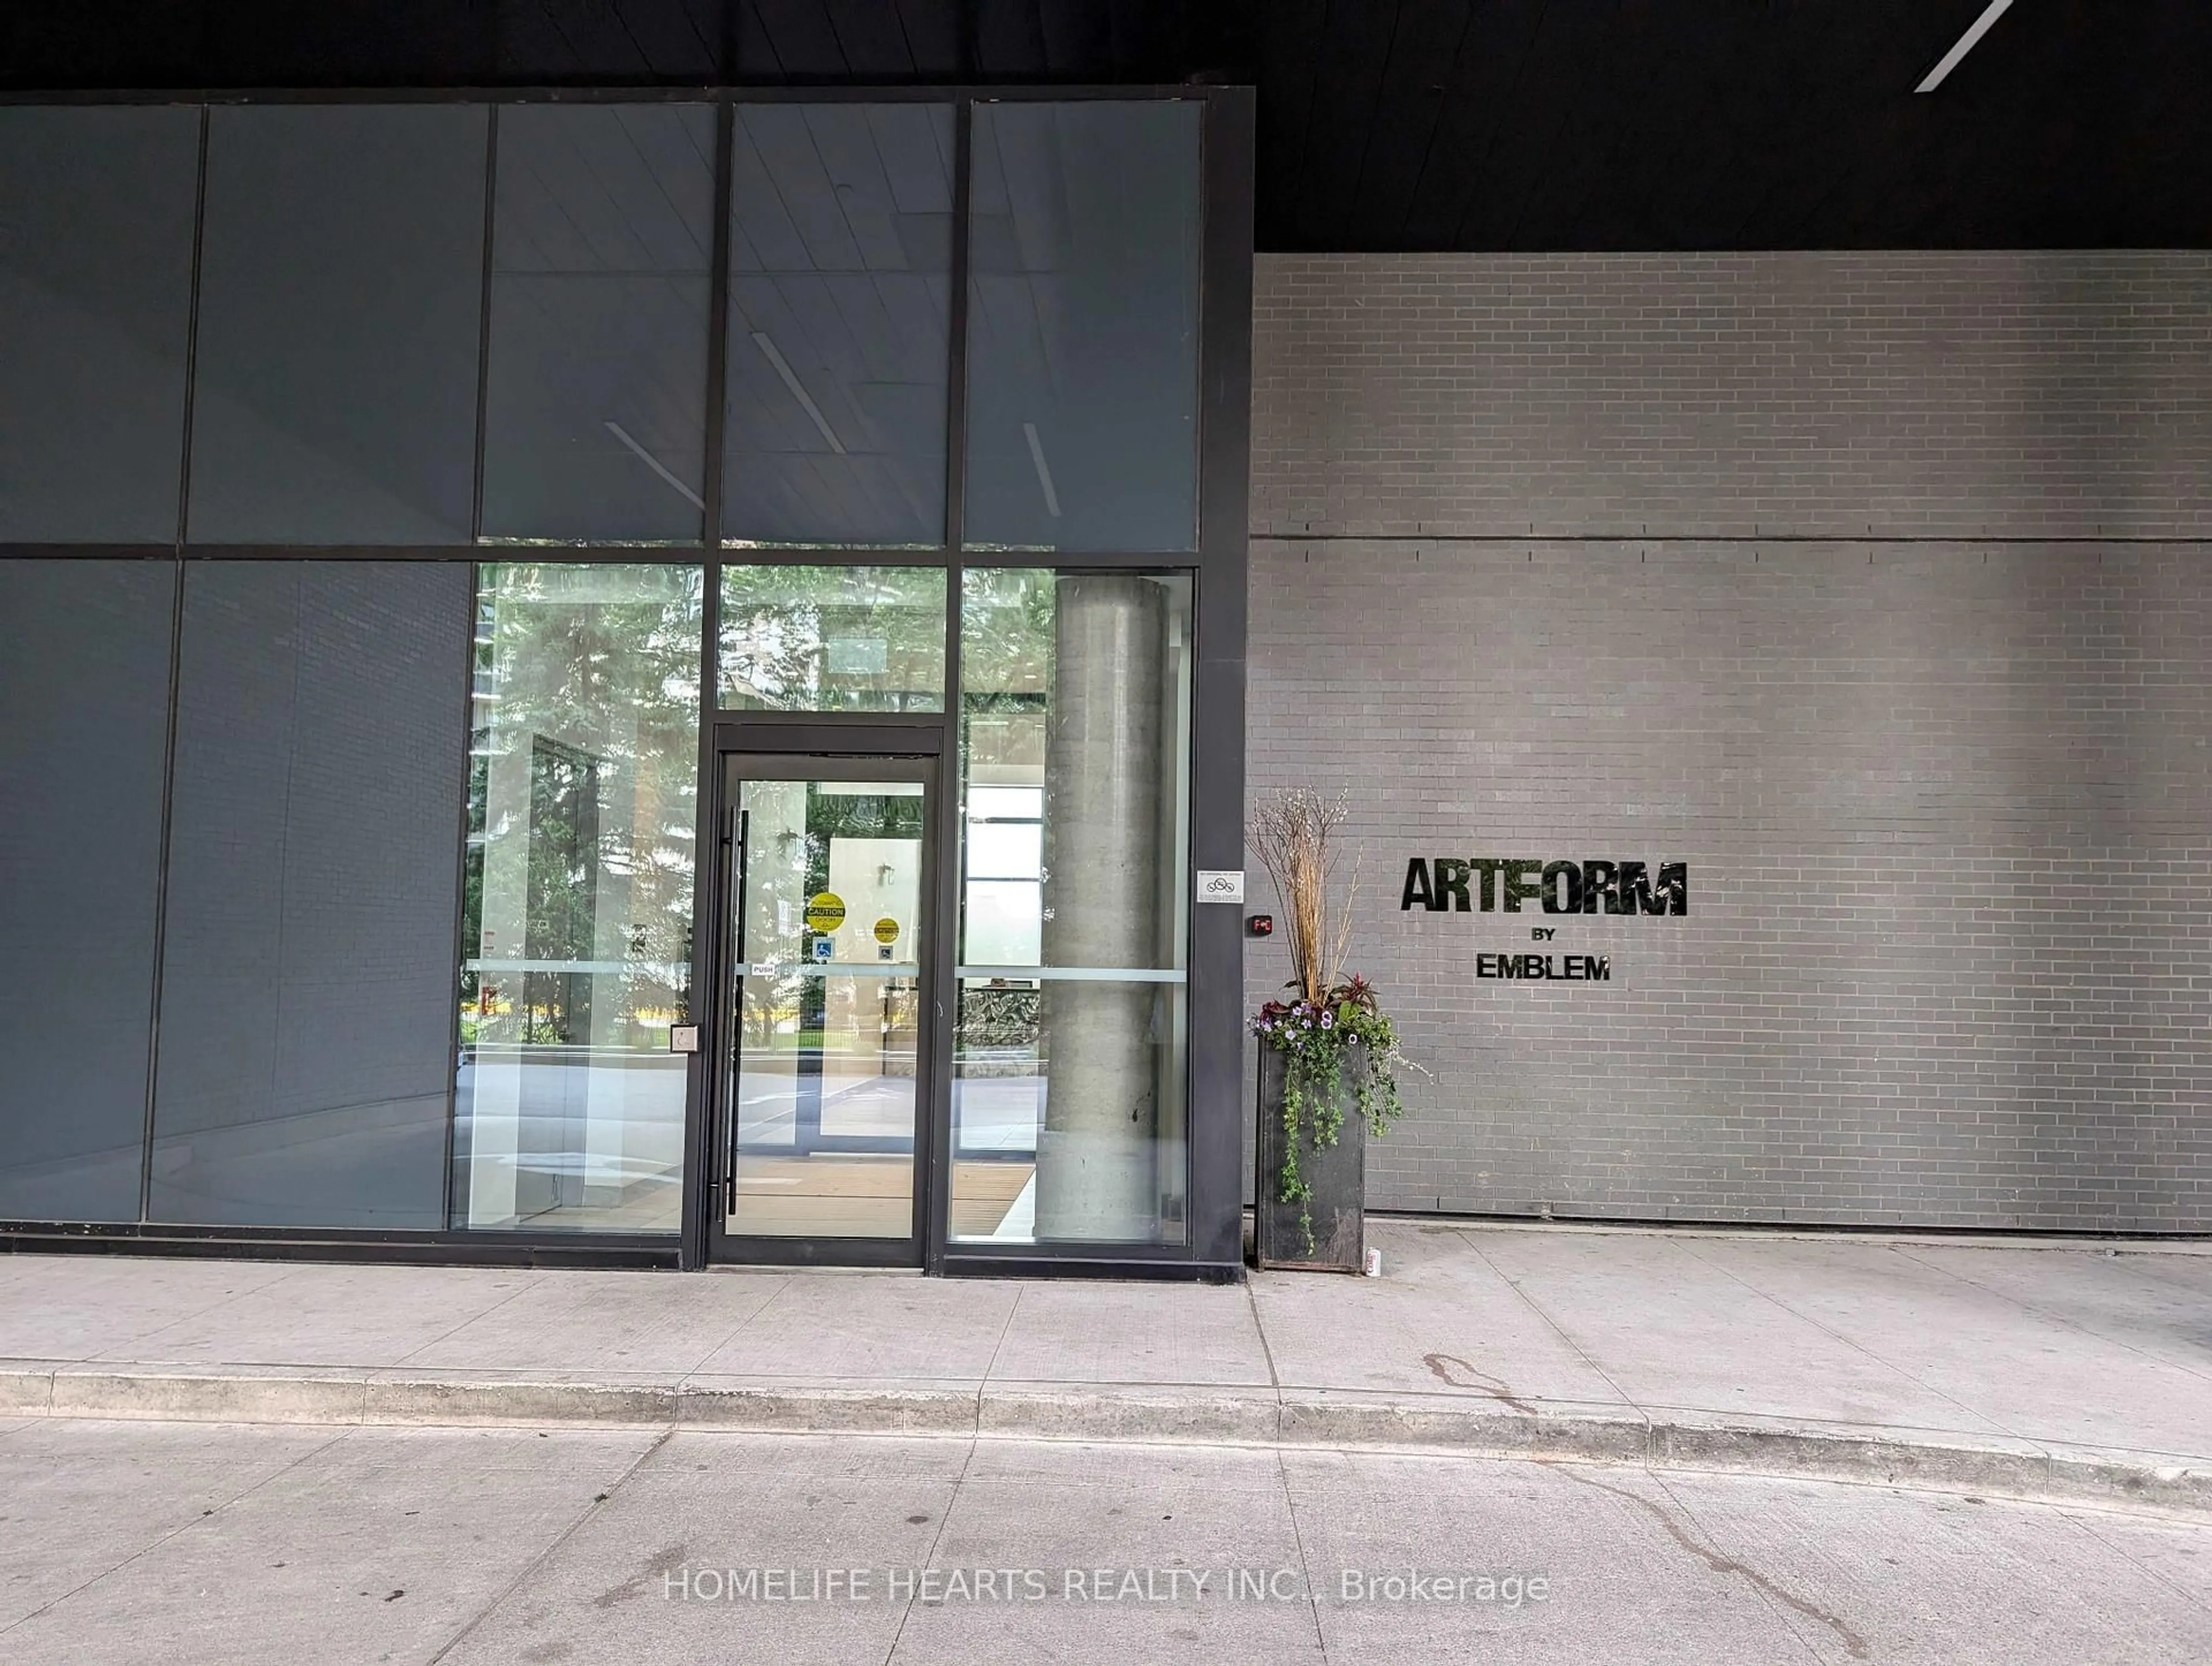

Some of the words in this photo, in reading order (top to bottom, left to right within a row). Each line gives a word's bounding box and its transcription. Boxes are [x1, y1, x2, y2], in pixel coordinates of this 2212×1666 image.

[1401, 858, 1688, 916] ARTFORM
[808, 907, 843, 915] CAUTION
[1531, 928, 1556, 941] BY
[1476, 953, 1611, 980] EMBLEM
